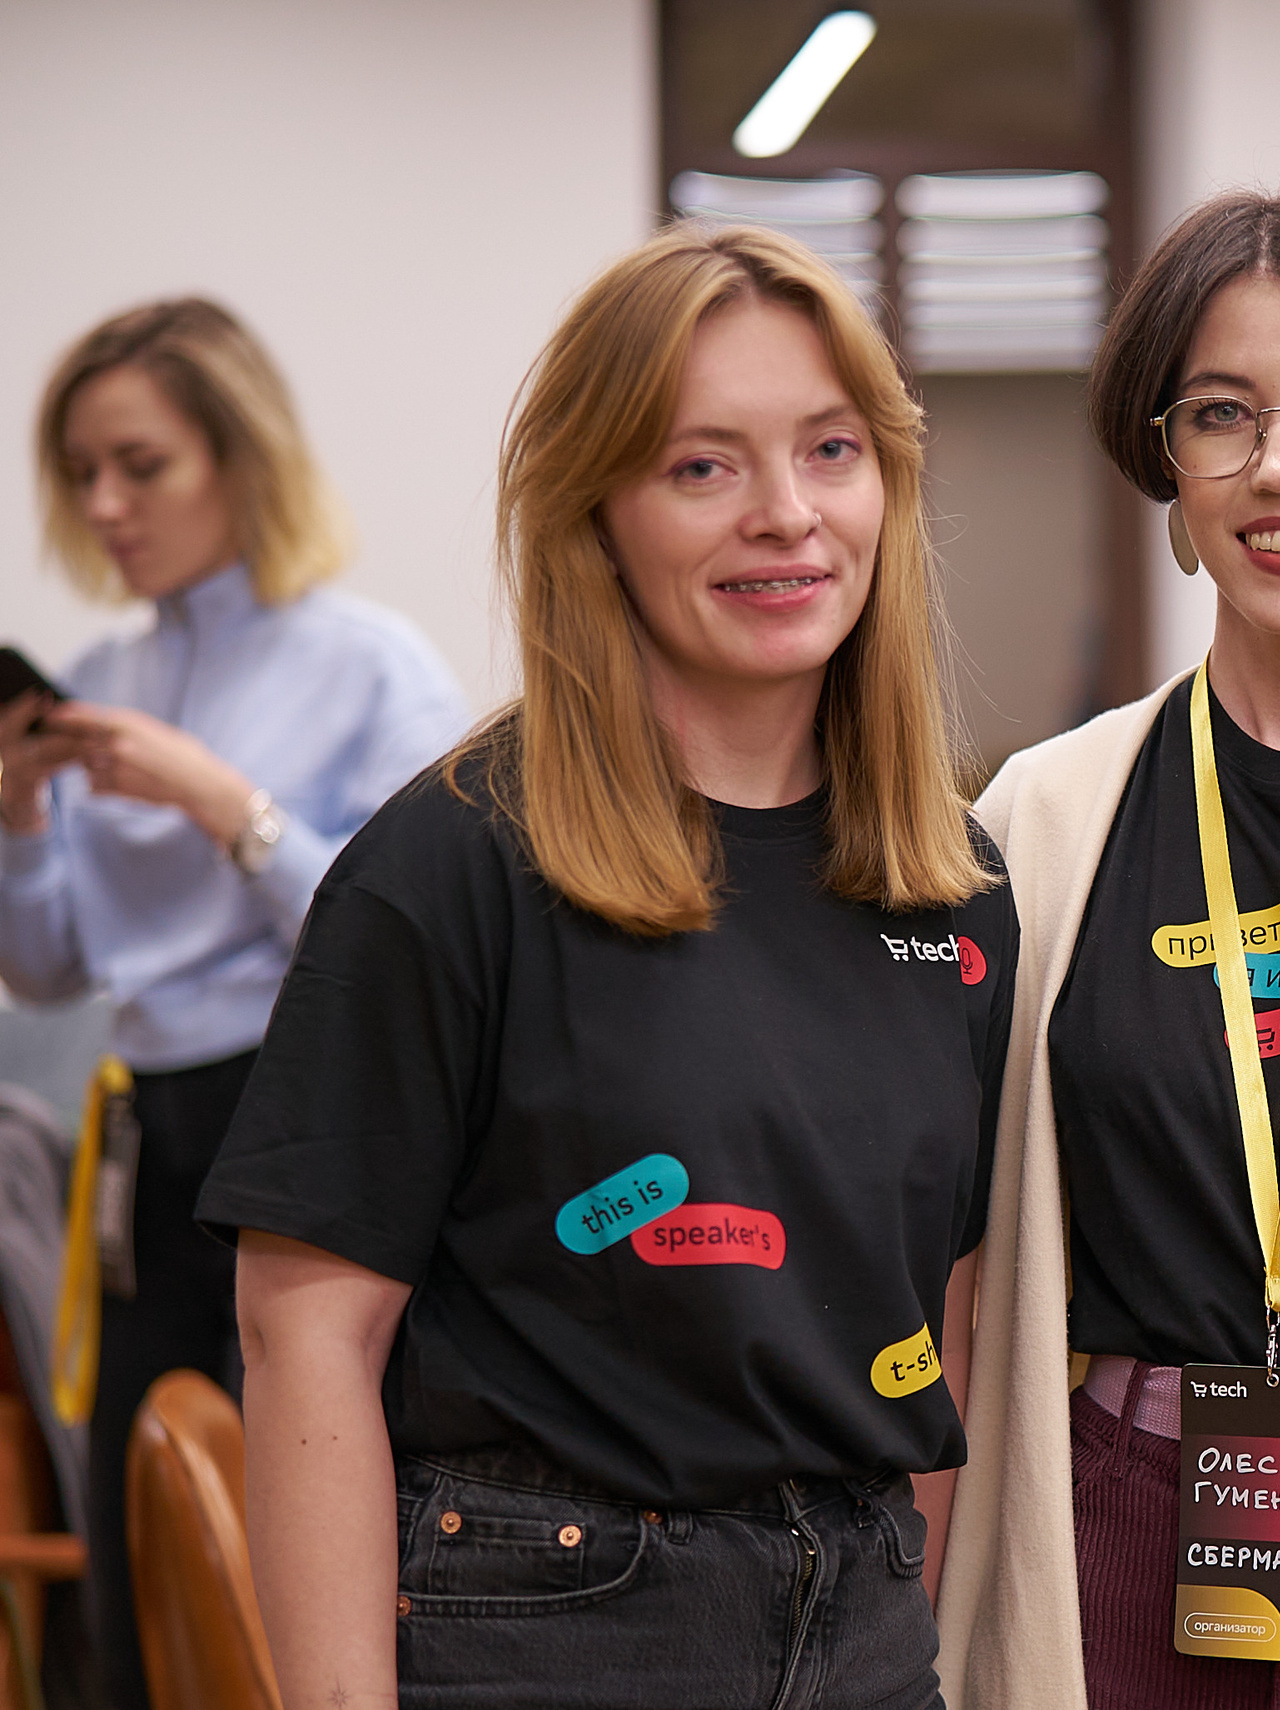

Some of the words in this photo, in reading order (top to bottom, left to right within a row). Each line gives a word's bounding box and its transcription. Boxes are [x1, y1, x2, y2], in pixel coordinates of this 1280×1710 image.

[910, 934, 960, 961] tech
[582, 1197, 634, 1234] this
[633, 1180, 664, 1205] is
[654, 1217, 771, 1252] speaker's
[1209, 1381, 1248, 1398] tech
[1194, 1620, 1267, 1636] организатор
